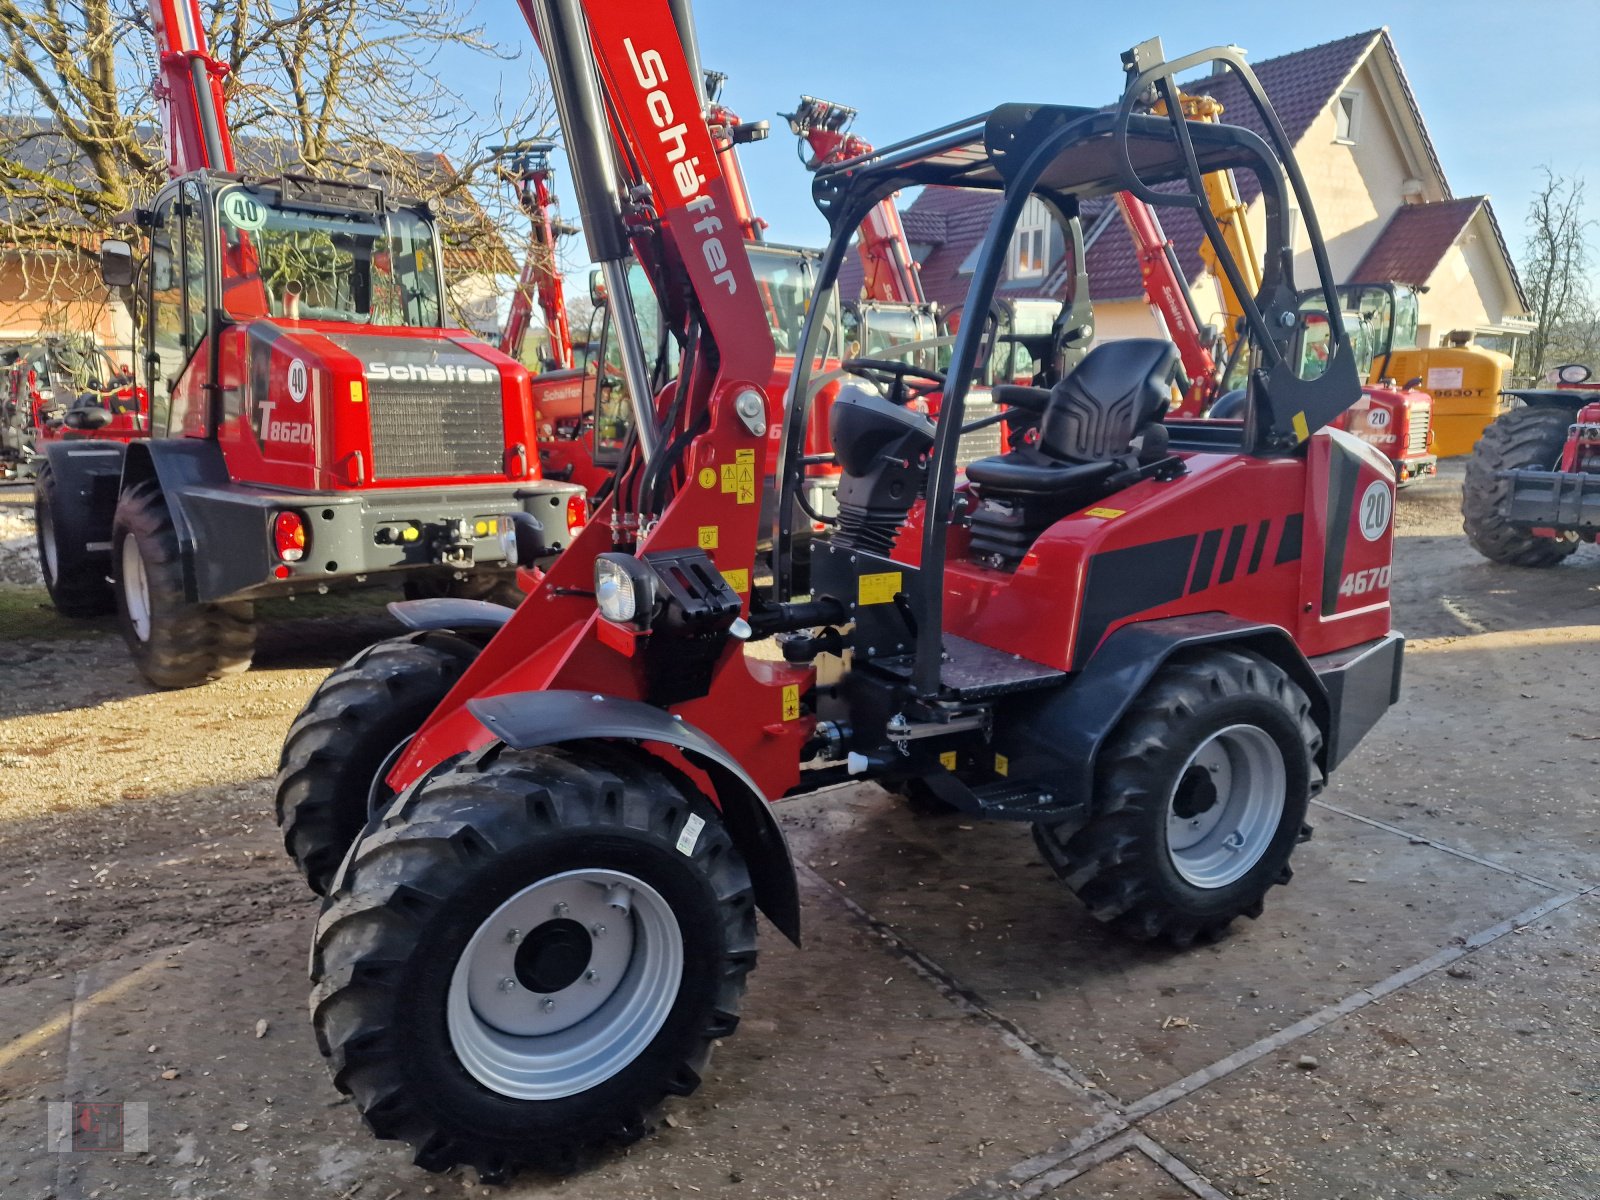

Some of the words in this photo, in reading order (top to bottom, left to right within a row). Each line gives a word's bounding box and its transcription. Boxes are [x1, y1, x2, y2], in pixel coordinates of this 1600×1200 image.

[623, 37, 738, 296] Schäffer
[233, 199, 258, 222] 40
[291, 367, 304, 394] 40
[362, 362, 500, 383] Schäffer
[1371, 412, 1386, 425] 20
[1365, 492, 1386, 530] 20
[1338, 565, 1392, 597] 4670
